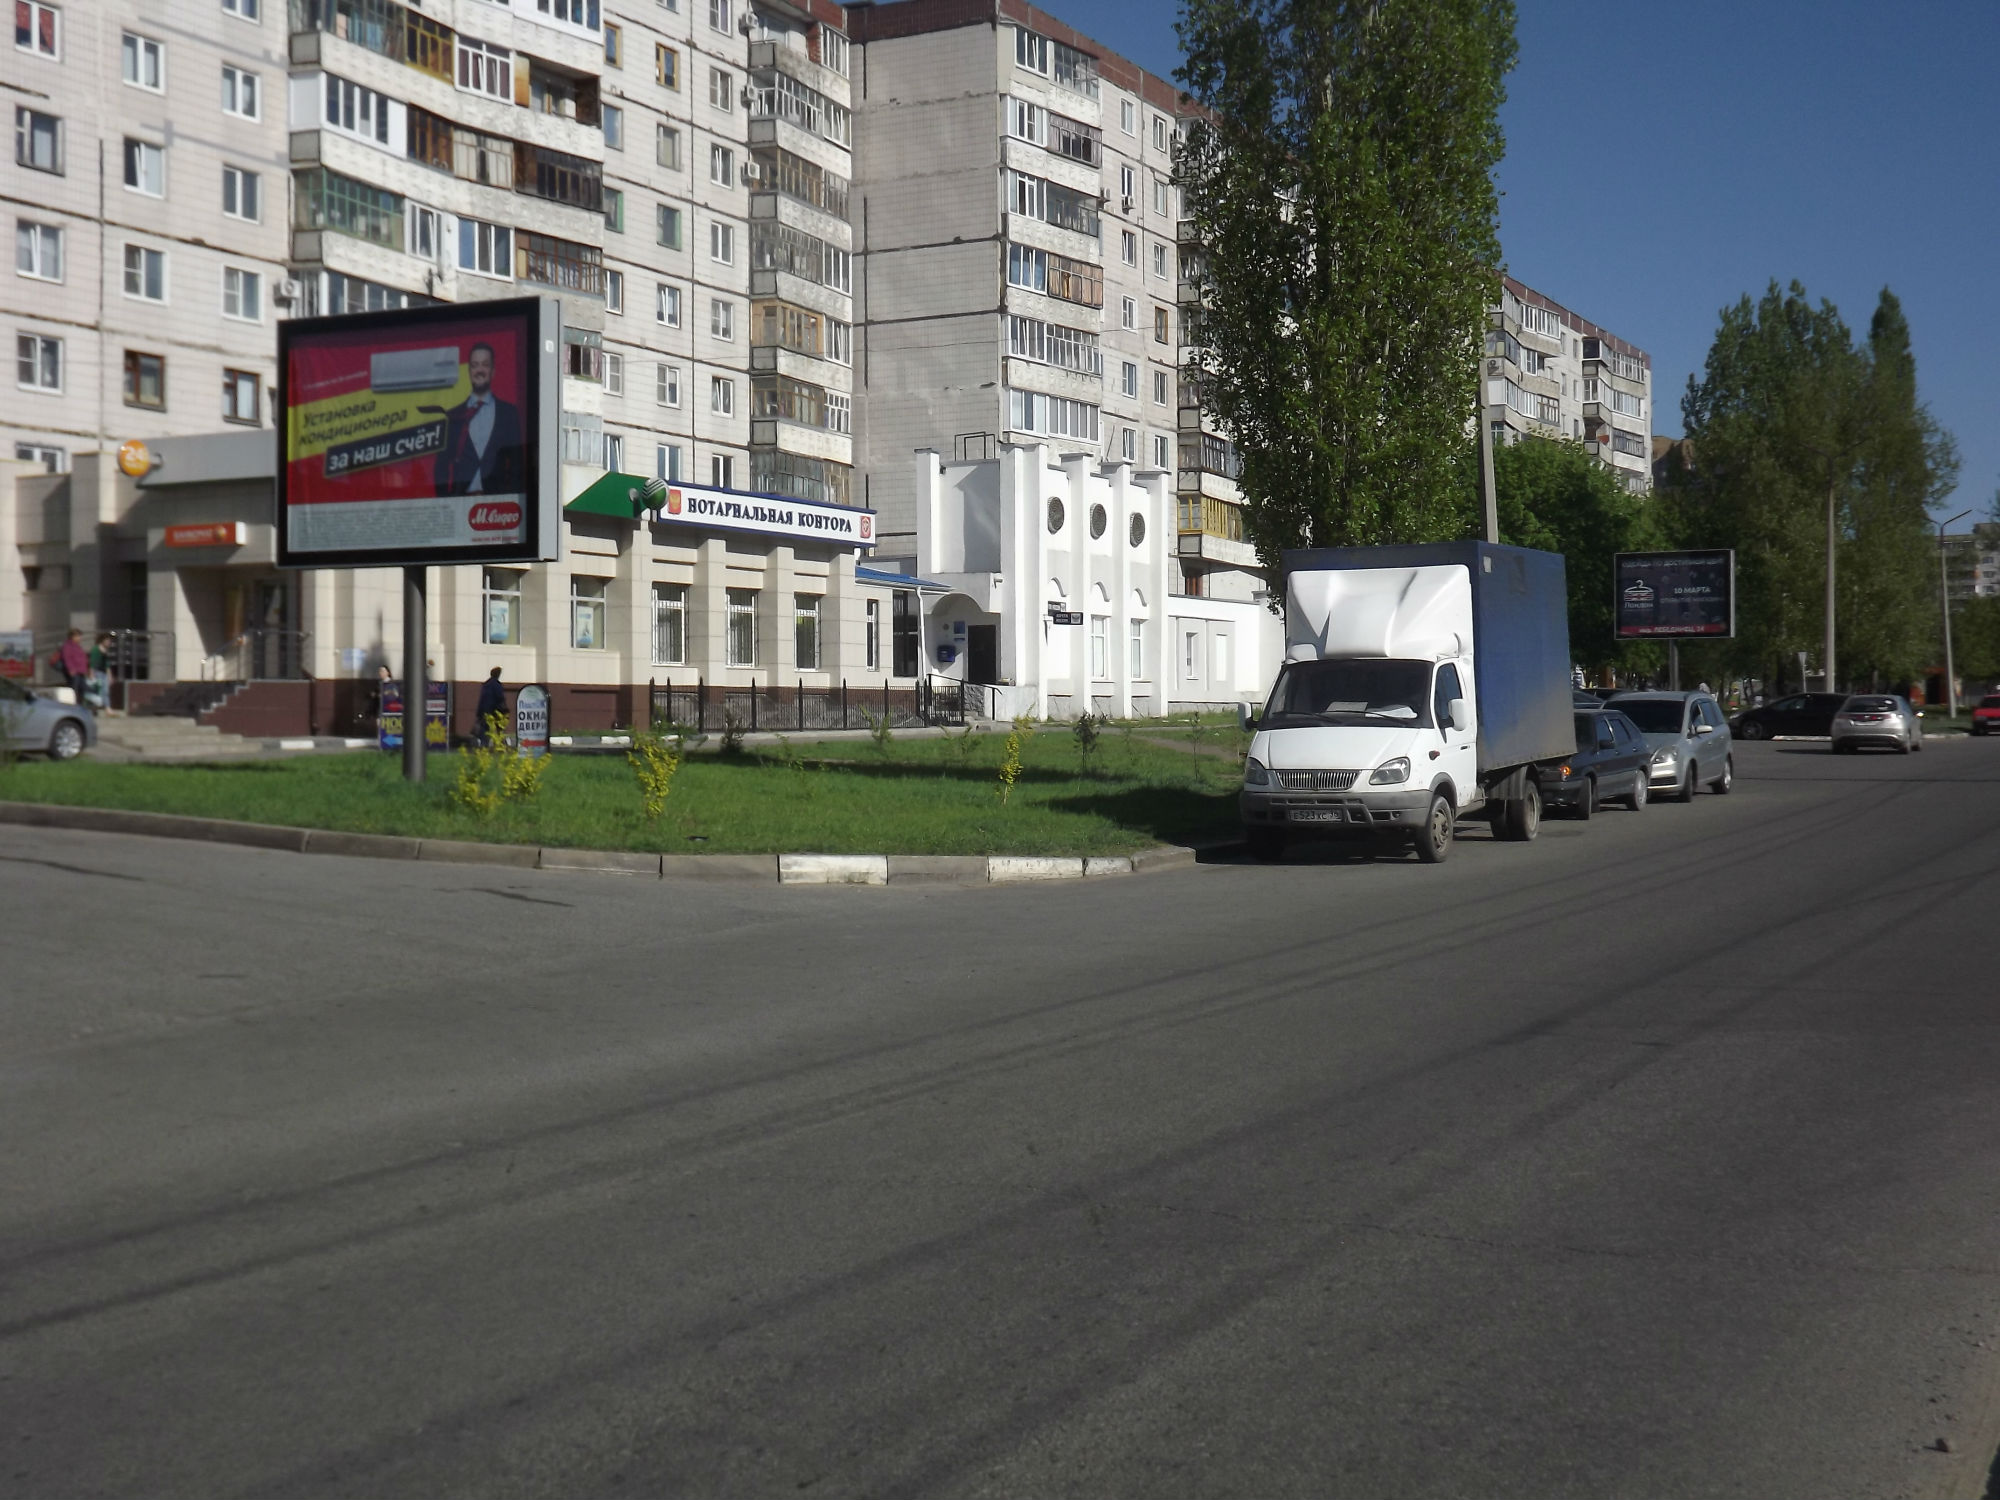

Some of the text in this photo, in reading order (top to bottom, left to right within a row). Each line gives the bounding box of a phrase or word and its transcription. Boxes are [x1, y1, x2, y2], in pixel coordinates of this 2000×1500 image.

[300, 409, 408, 445] кондиционера
[303, 400, 376, 428] Установка
[329, 425, 441, 471] за наш счёт!
[687, 498, 853, 533] НОТАРИАЛЬНАЯ КОНТОРА
[519, 711, 547, 721] ОКНА
